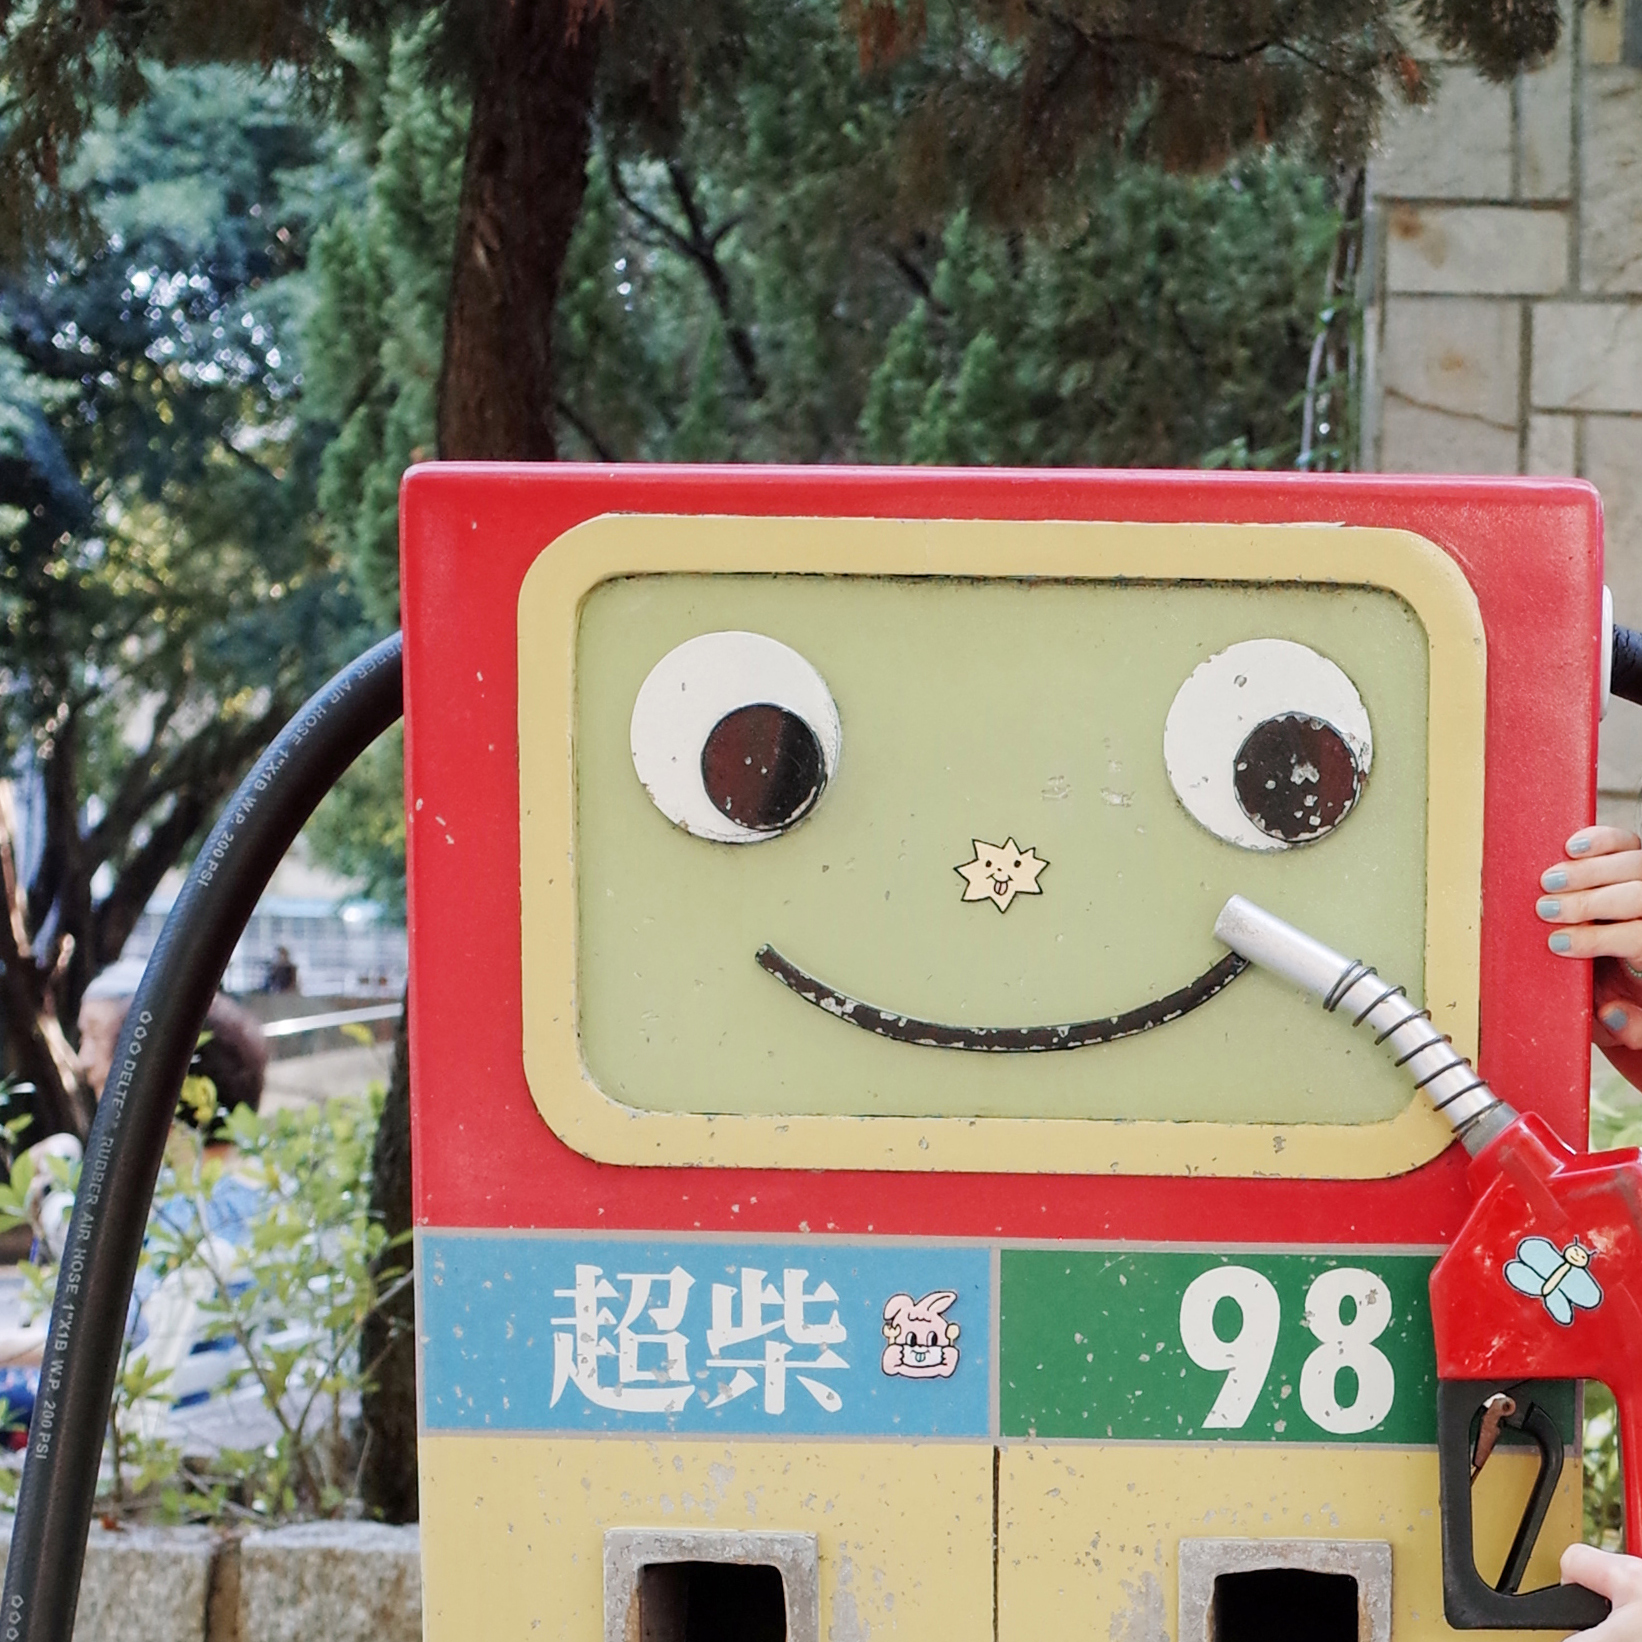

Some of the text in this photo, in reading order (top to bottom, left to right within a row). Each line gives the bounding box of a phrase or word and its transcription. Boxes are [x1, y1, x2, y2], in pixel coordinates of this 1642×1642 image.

[330, 680, 353, 705] AIR
[291, 704, 327, 745] HOSE
[213, 830, 235, 859] 200
[197, 859, 218, 887] PSI
[112, 1059, 137, 1128] DELTE
[86, 1136, 114, 1206] RUBBER
[77, 1211, 94, 1241] AIR
[66, 1247, 87, 1295] HOSE
[549, 1262, 850, 1416] 超柴
[1179, 1265, 1397, 1434] 98
[40, 1400, 57, 1429] 200
[35, 1431, 51, 1460] PSI
